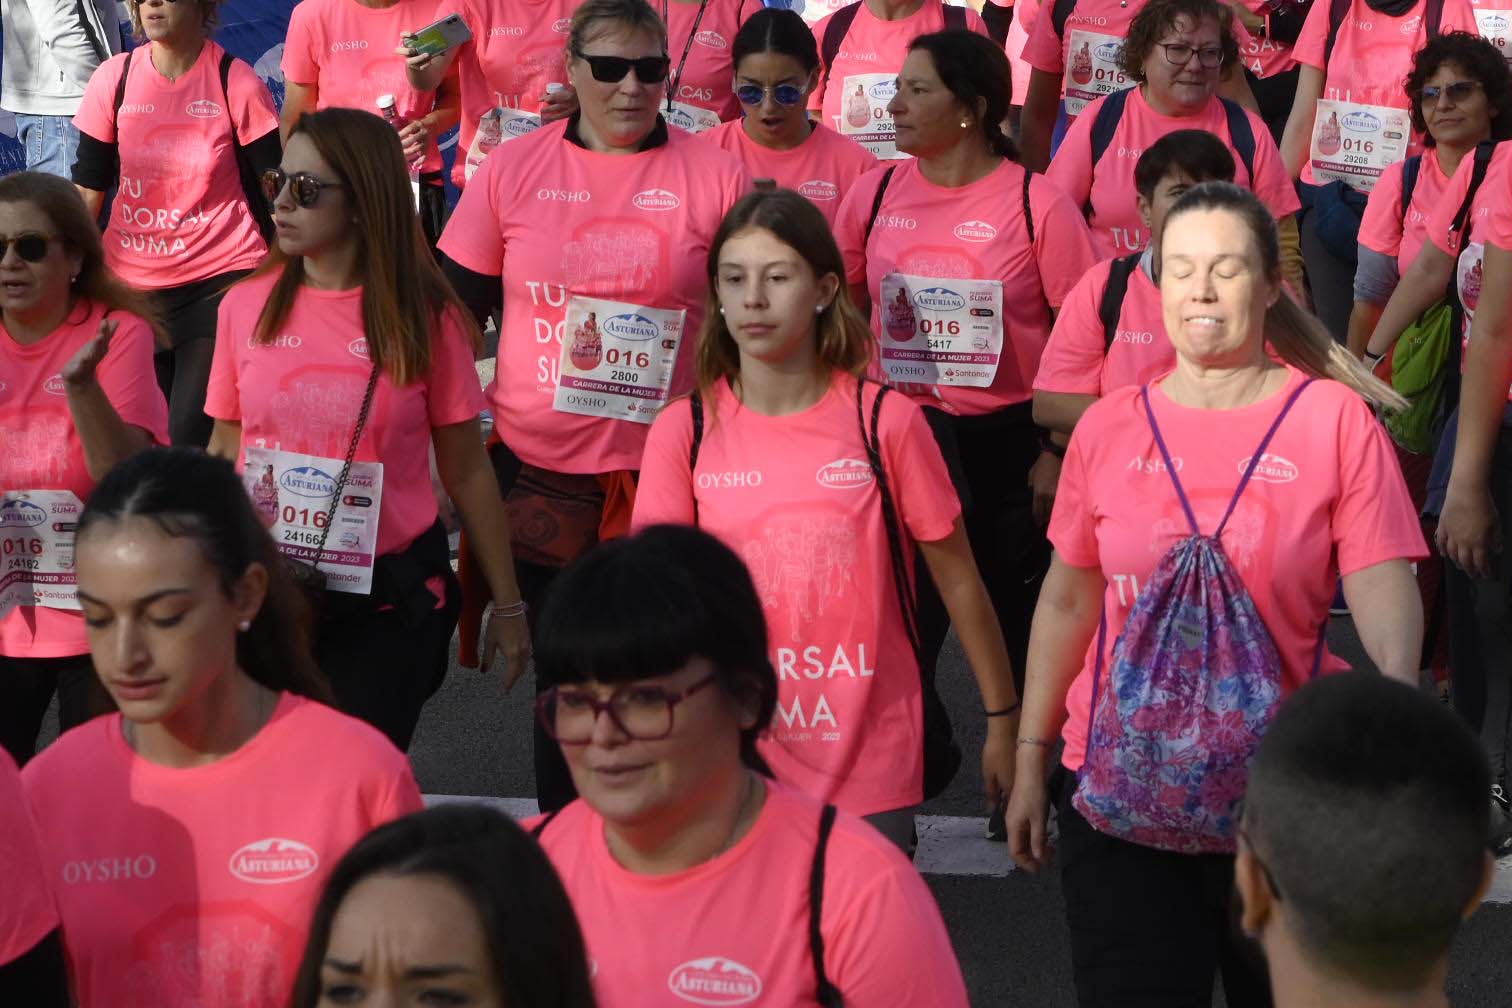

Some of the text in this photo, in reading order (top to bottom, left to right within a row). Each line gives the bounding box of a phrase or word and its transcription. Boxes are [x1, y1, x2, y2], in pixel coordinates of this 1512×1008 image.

[1070, 15, 1108, 26] OYSHO
[487, 26, 524, 38] OYSHO
[330, 40, 369, 53] OYSHO
[1491, 36, 1506, 47] 16
[1095, 68, 1126, 84] 016
[1345, 118, 1378, 129] ASTURIANA
[1343, 138, 1374, 153] 016
[1343, 154, 1369, 165] 29208
[123, 176, 142, 198] TU
[536, 188, 591, 203] OYSHO
[633, 194, 679, 208] ASTURIANA
[123, 202, 209, 231] DORSAL
[874, 215, 917, 230] OYSHO
[957, 227, 993, 239] ASTURIANA
[1110, 226, 1141, 251] TU
[120, 230, 189, 257] SUMA
[525, 281, 566, 308] TU
[918, 295, 961, 307] ASTURIANA
[969, 294, 993, 302] SUMA
[607, 320, 655, 337] ASTURIANA
[919, 319, 961, 335] 016
[927, 339, 952, 349] 5417
[605, 347, 650, 368] 016
[610, 369, 639, 383] 2800
[890, 364, 926, 377] OYSHO
[955, 369, 990, 378] Santander
[572, 379, 607, 391] CARRERA
[633, 388, 656, 397] MUJER
[567, 394, 607, 409] OYSHO
[343, 478, 373, 488] SUMA
[698, 469, 763, 489] OYSHO
[821, 469, 874, 482] ASTURIANA
[284, 475, 334, 494] ASTURIANA
[51, 506, 78, 514] SUMA
[282, 505, 329, 529] 016
[3, 537, 43, 555] 016
[286, 547, 297, 555] DE
[298, 549, 309, 557] LA
[341, 554, 360, 563] 2023
[33, 575, 59, 583] MUJER
[327, 571, 362, 583] ntander
[777, 642, 876, 682] RSAL
[776, 693, 838, 729] MA
[63, 853, 157, 885] OYSHO
[236, 854, 312, 875] ASTURIANA
[673, 970, 755, 995] ASTURIANA
